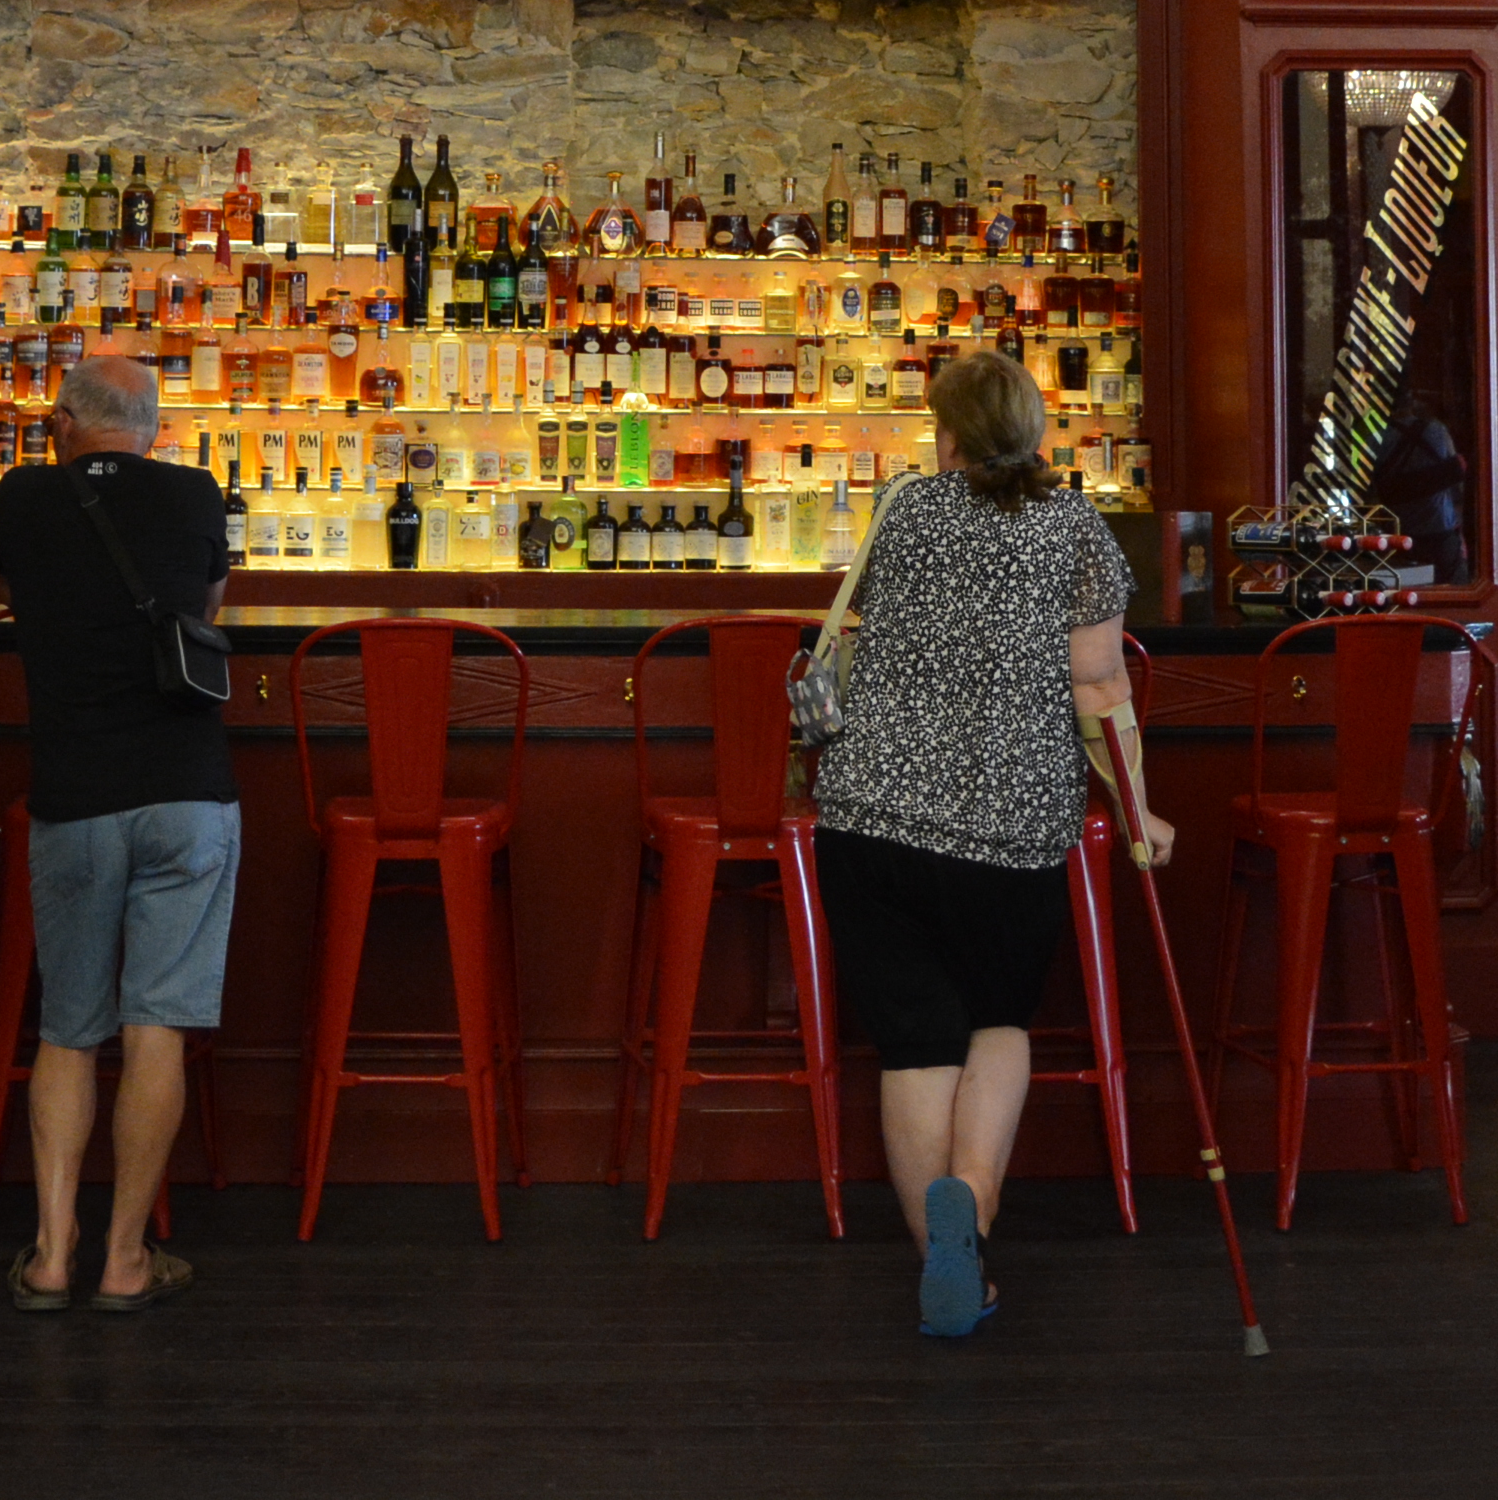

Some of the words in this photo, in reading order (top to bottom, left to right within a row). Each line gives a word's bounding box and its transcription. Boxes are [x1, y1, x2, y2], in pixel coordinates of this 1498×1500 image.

[234, 209, 252, 223] 46
[630, 410, 640, 471] LEBLON
[796, 488, 819, 507] GIN
[388, 517, 420, 526] BULLDOG
[286, 526, 310, 541] EG
[326, 526, 345, 537] EG
